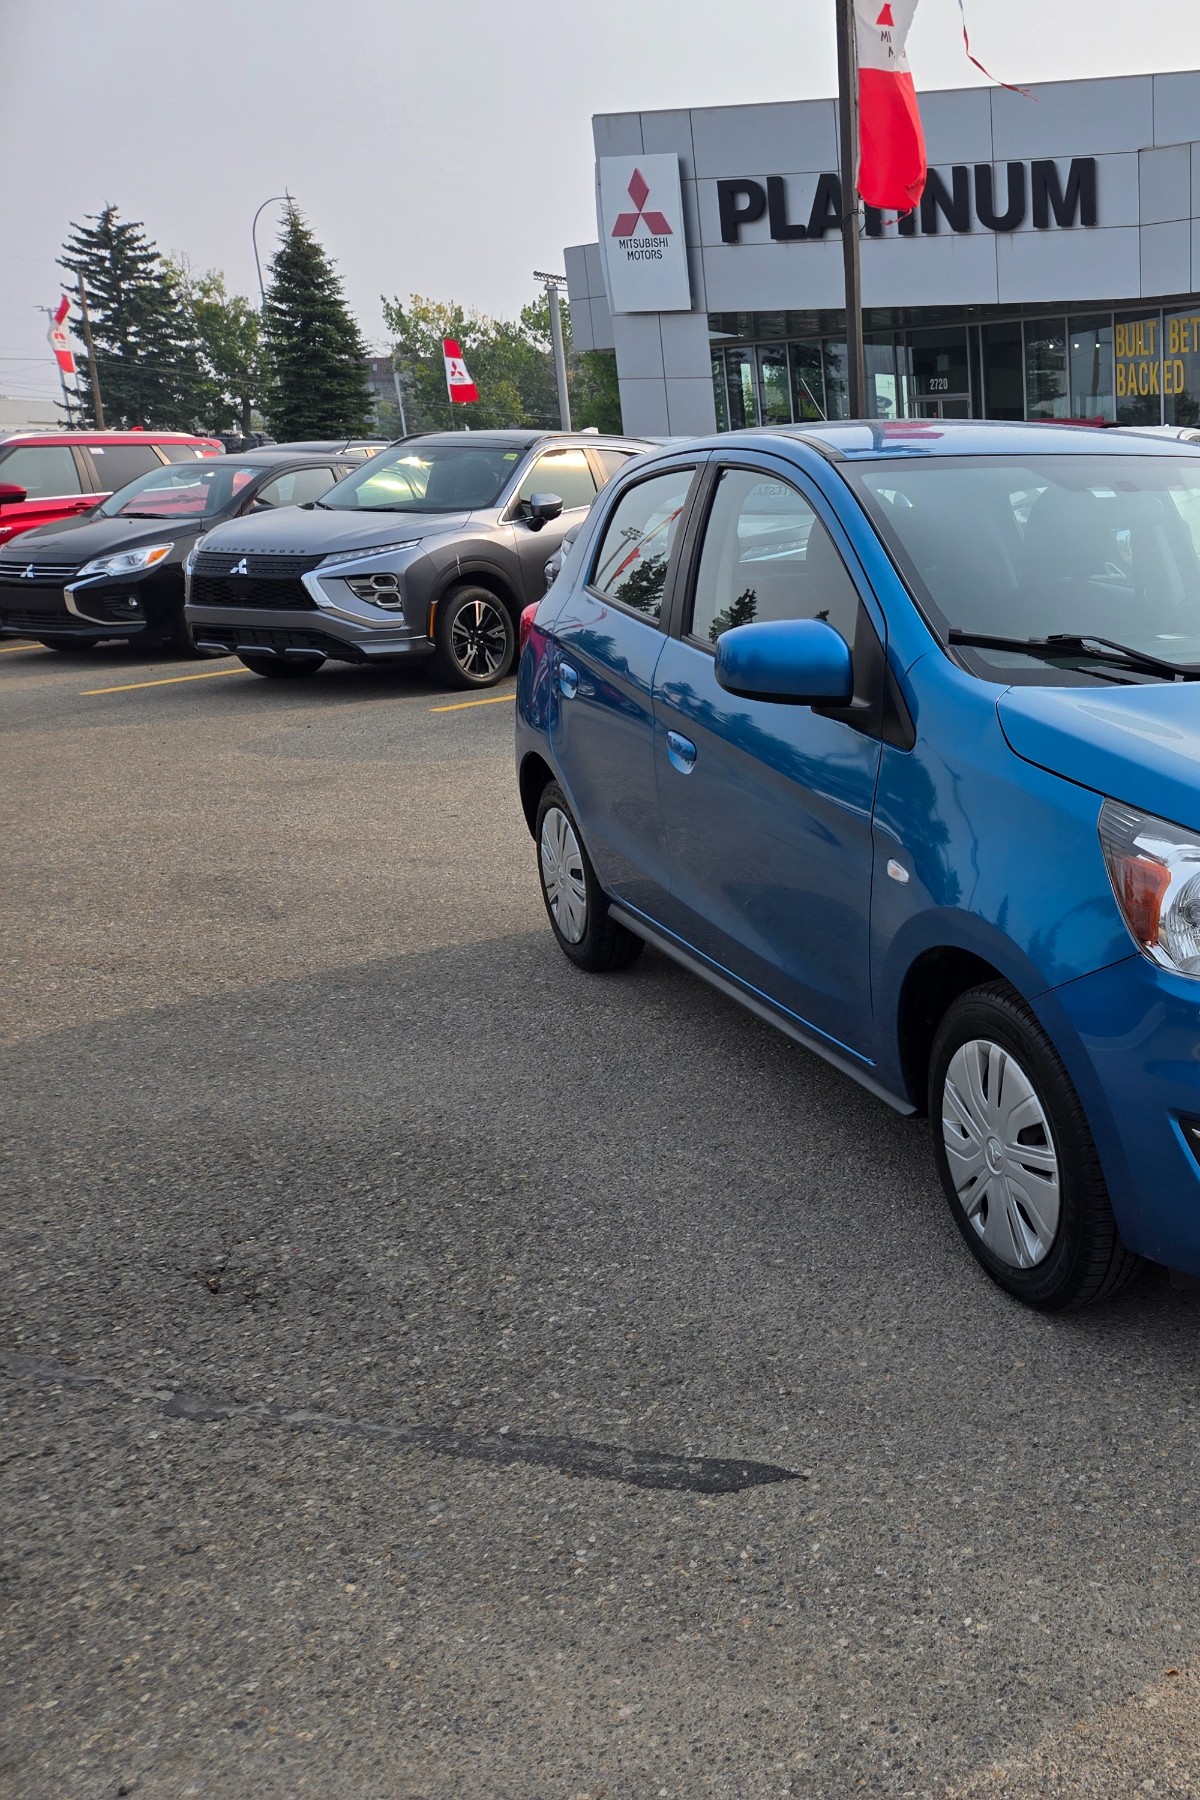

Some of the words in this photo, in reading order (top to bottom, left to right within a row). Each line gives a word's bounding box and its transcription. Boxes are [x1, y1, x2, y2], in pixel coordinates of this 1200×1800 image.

[618, 237, 669, 249] MITSUBISHI
[626, 249, 663, 261] MOTORS
[1115, 320, 1157, 358] BUILT
[929, 377, 949, 390] 2720
[1115, 359, 1185, 397] BACKED
